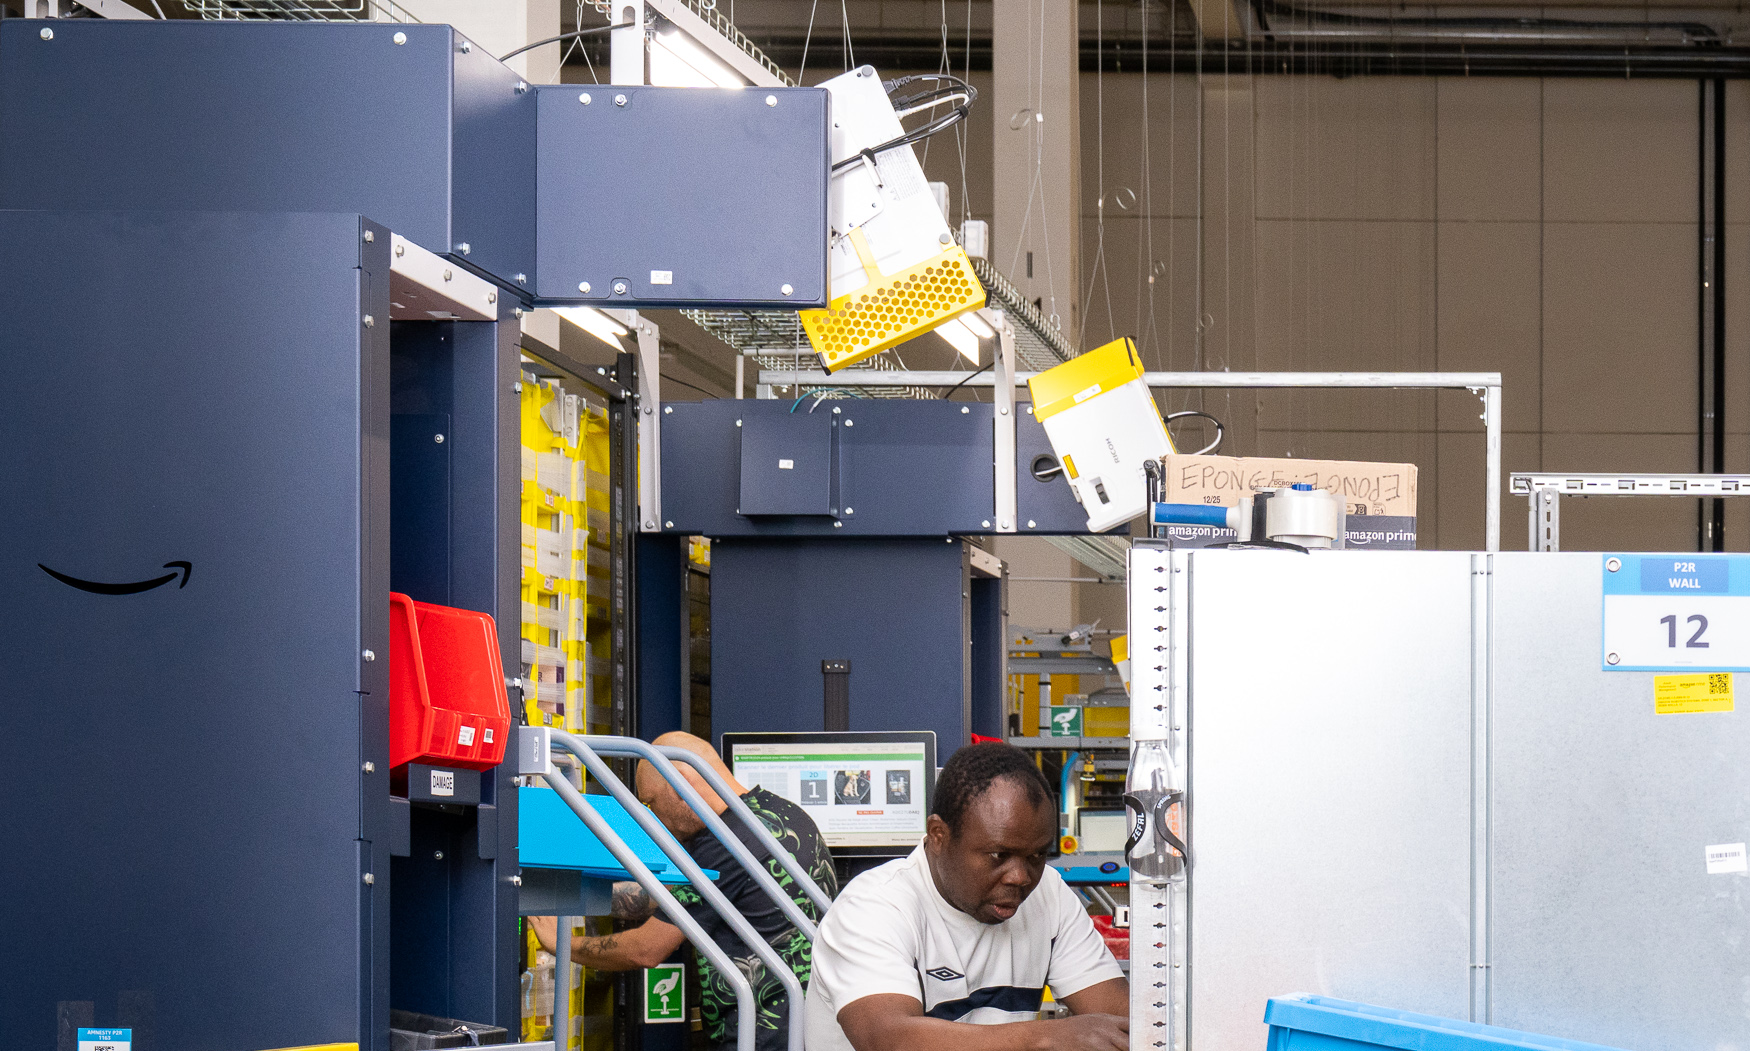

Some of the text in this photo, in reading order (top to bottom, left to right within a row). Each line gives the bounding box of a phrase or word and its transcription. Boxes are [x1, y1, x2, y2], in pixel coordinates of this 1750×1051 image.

[1203, 495, 1221, 505] 12/25
[1168, 526, 1211, 537] amazon
[1344, 531, 1385, 542] amazon
[1674, 562, 1696, 573] P2R
[1668, 578, 1701, 589] WALL
[1660, 614, 1710, 648] 12
[432, 775, 453, 789] DAMAGE
[808, 781, 820, 798] 1
